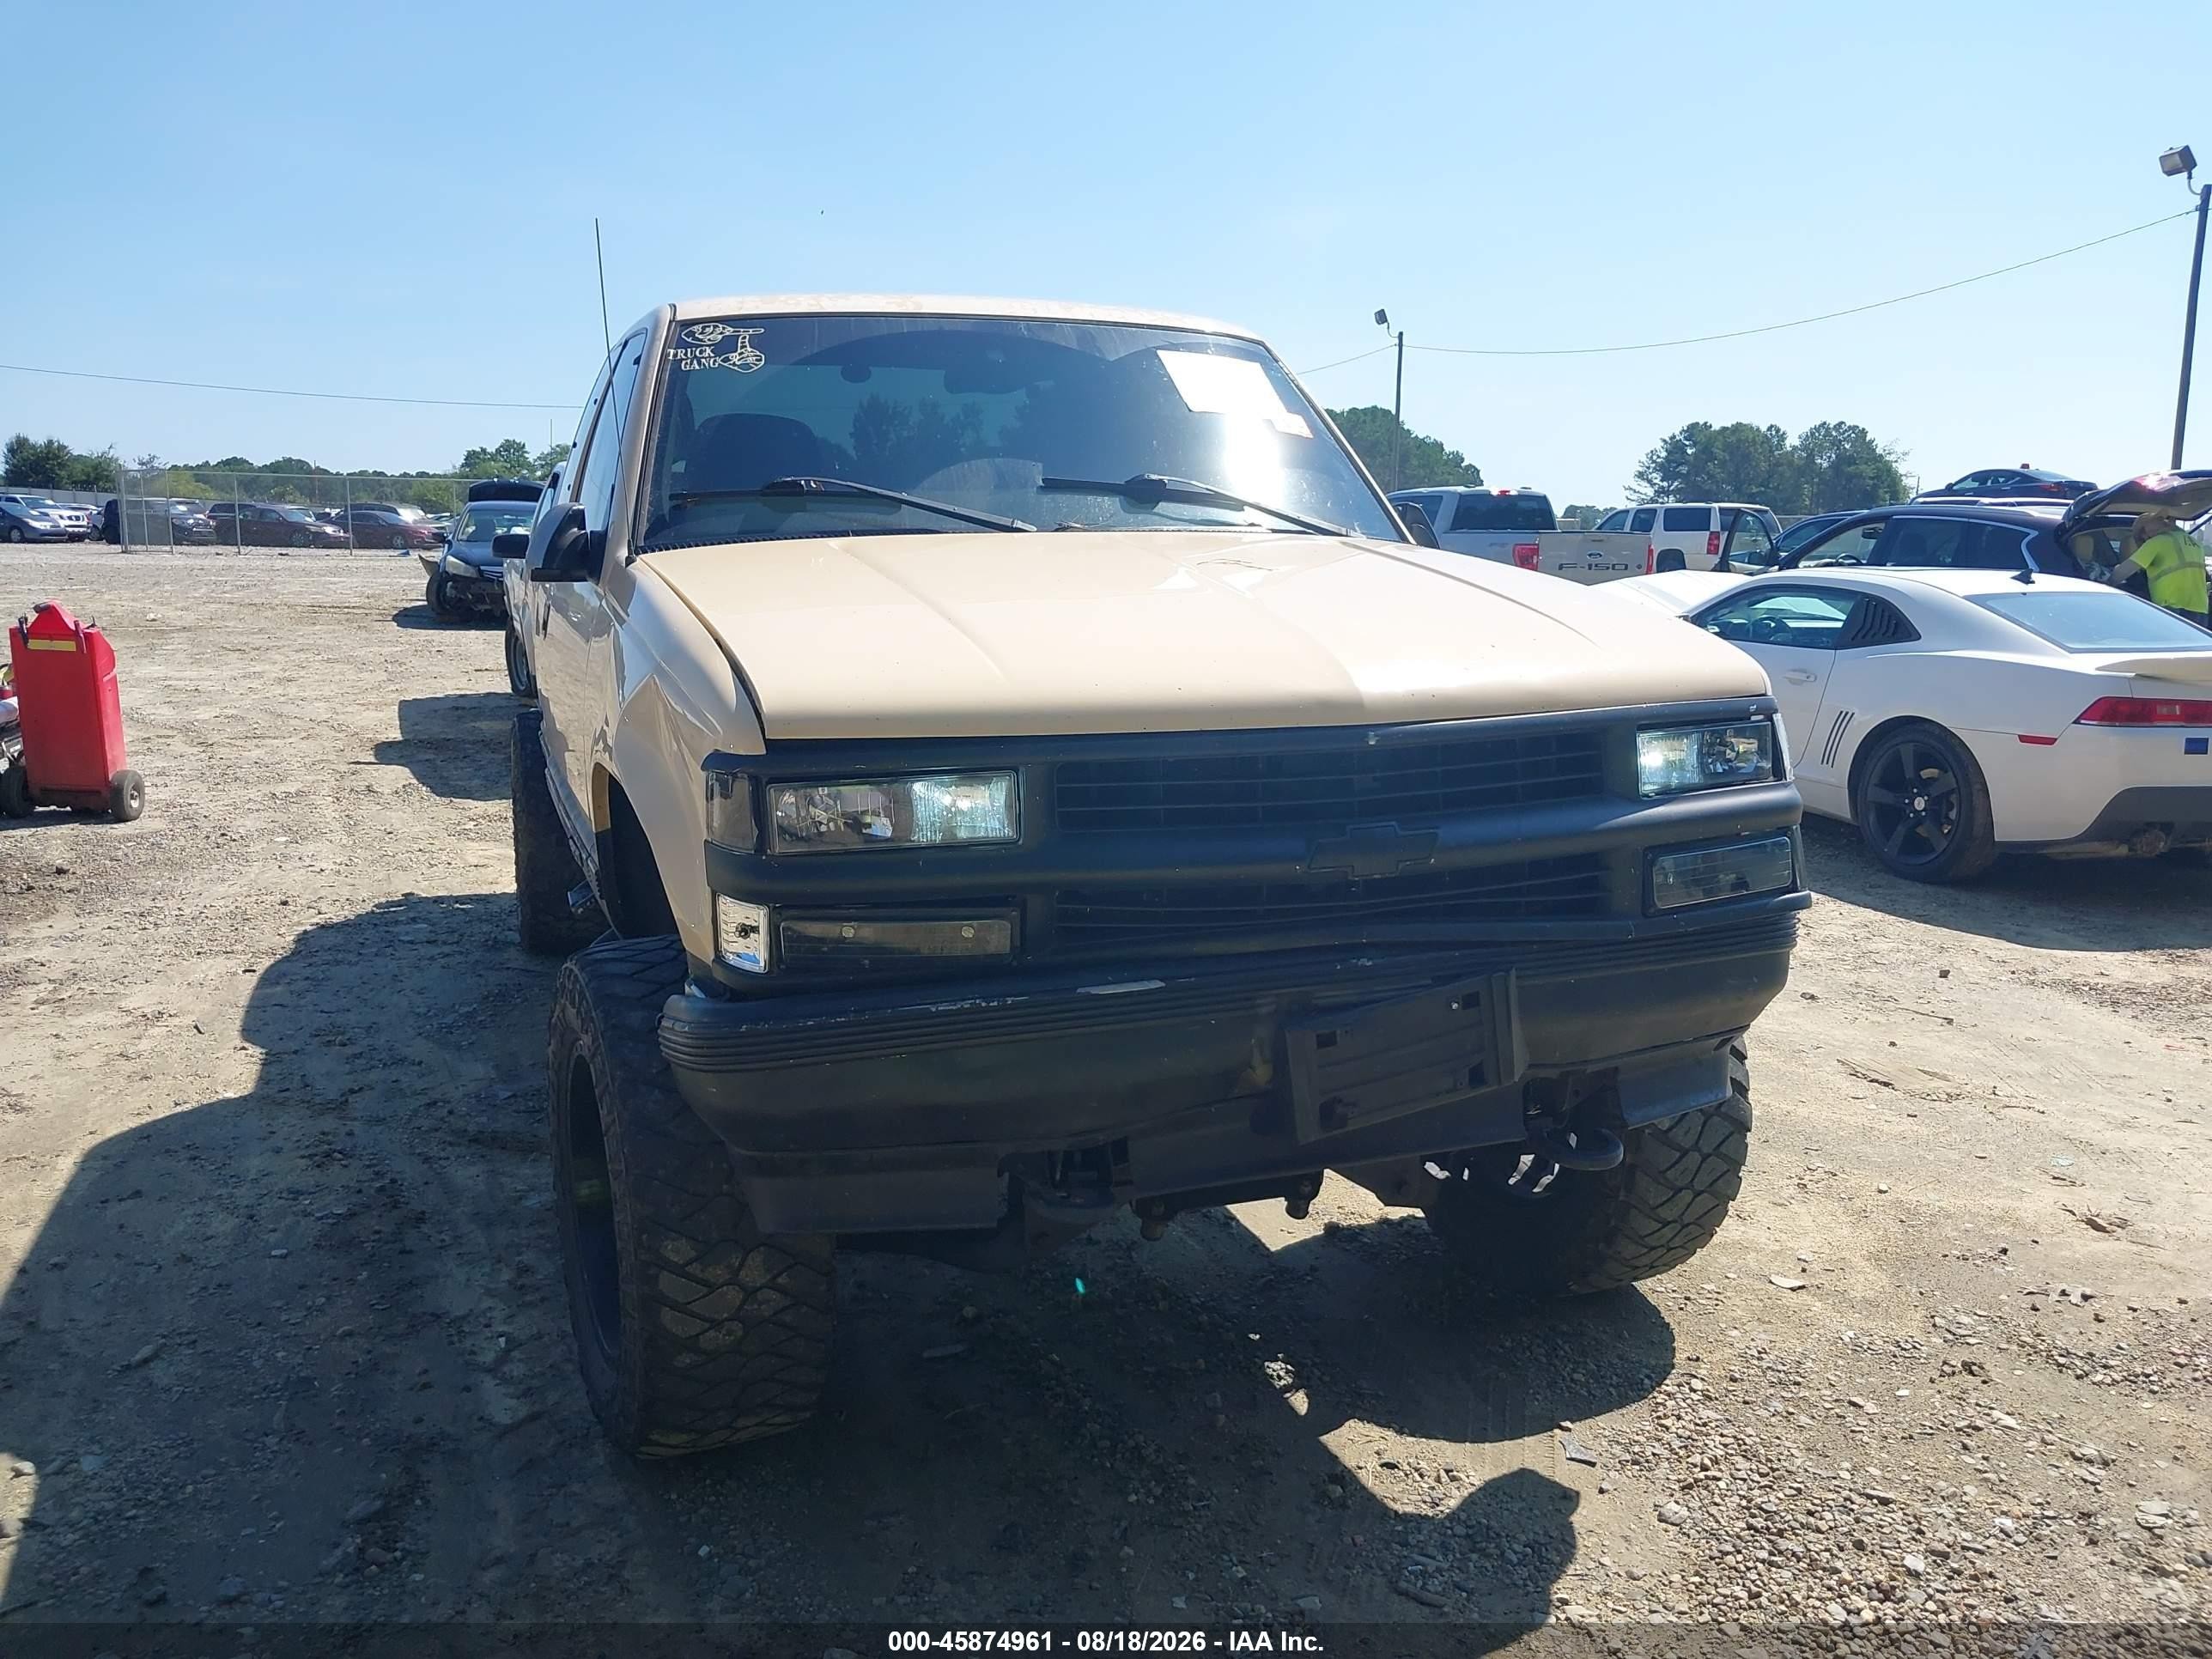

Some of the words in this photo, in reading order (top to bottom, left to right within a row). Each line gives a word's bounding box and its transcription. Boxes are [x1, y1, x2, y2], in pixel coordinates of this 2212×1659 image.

[667, 346, 715, 360] TRUCK
[681, 356, 720, 371] GANG
[1558, 562, 1629, 571] F-150
